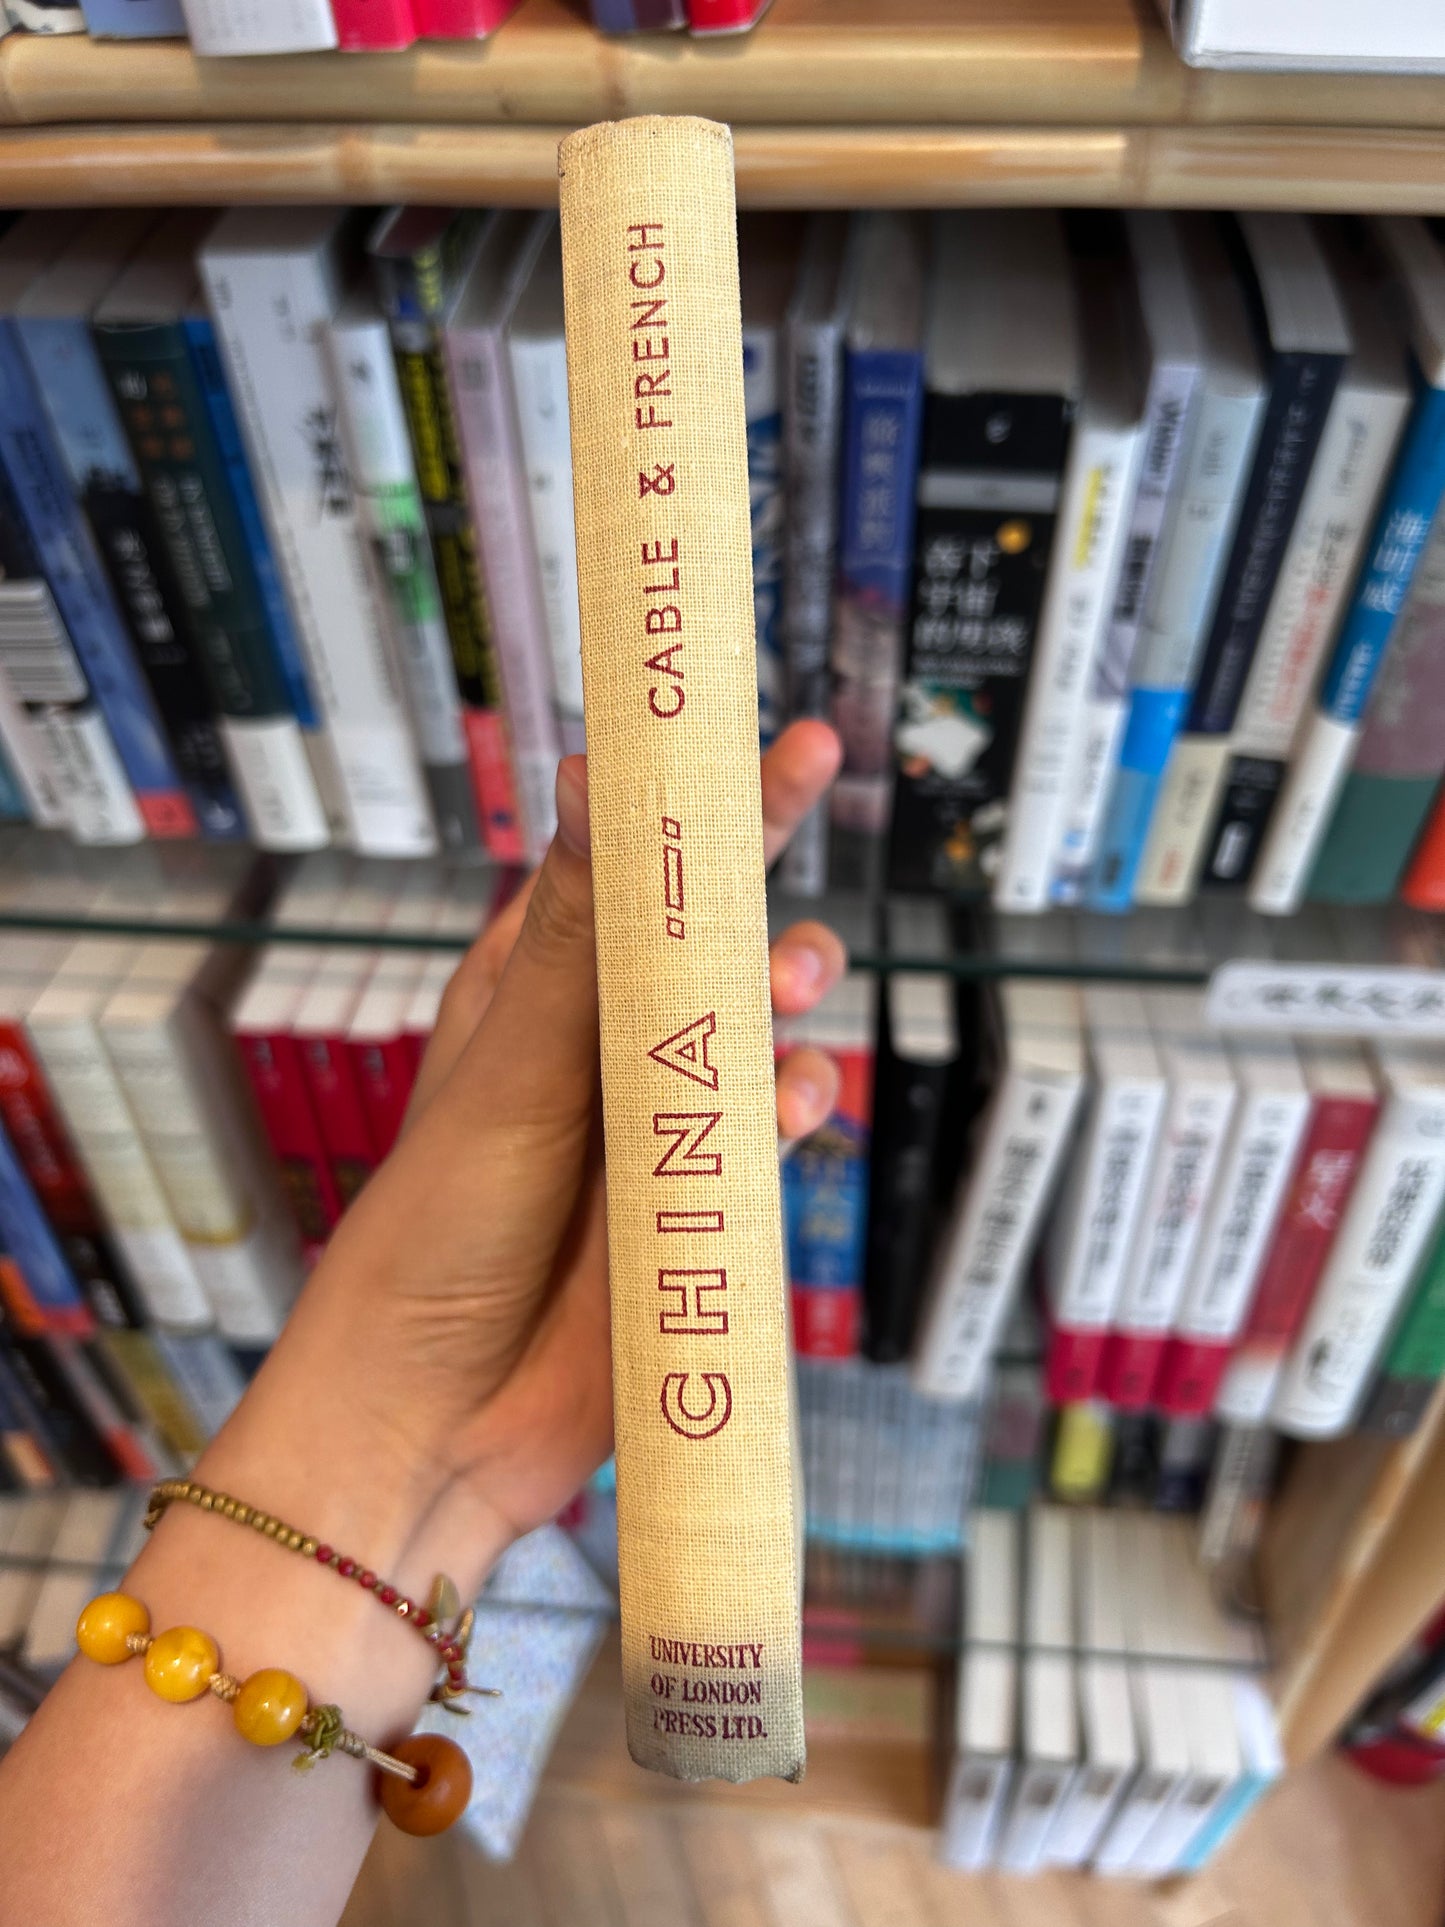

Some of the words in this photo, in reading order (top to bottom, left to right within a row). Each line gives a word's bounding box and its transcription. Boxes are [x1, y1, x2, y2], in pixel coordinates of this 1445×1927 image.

[627, 222, 673, 430] FRENCH
[638, 462, 675, 498] &
[641, 537, 685, 719] CABLE
[647, 1011, 733, 1440] CHINA
[650, 1635, 763, 1668] UNIVERSITY
[651, 1672, 676, 1699] OF
[681, 1678, 762, 1705] LONDON
[653, 1709, 717, 1738] PRESS
[721, 1714, 768, 1739] LTD.
